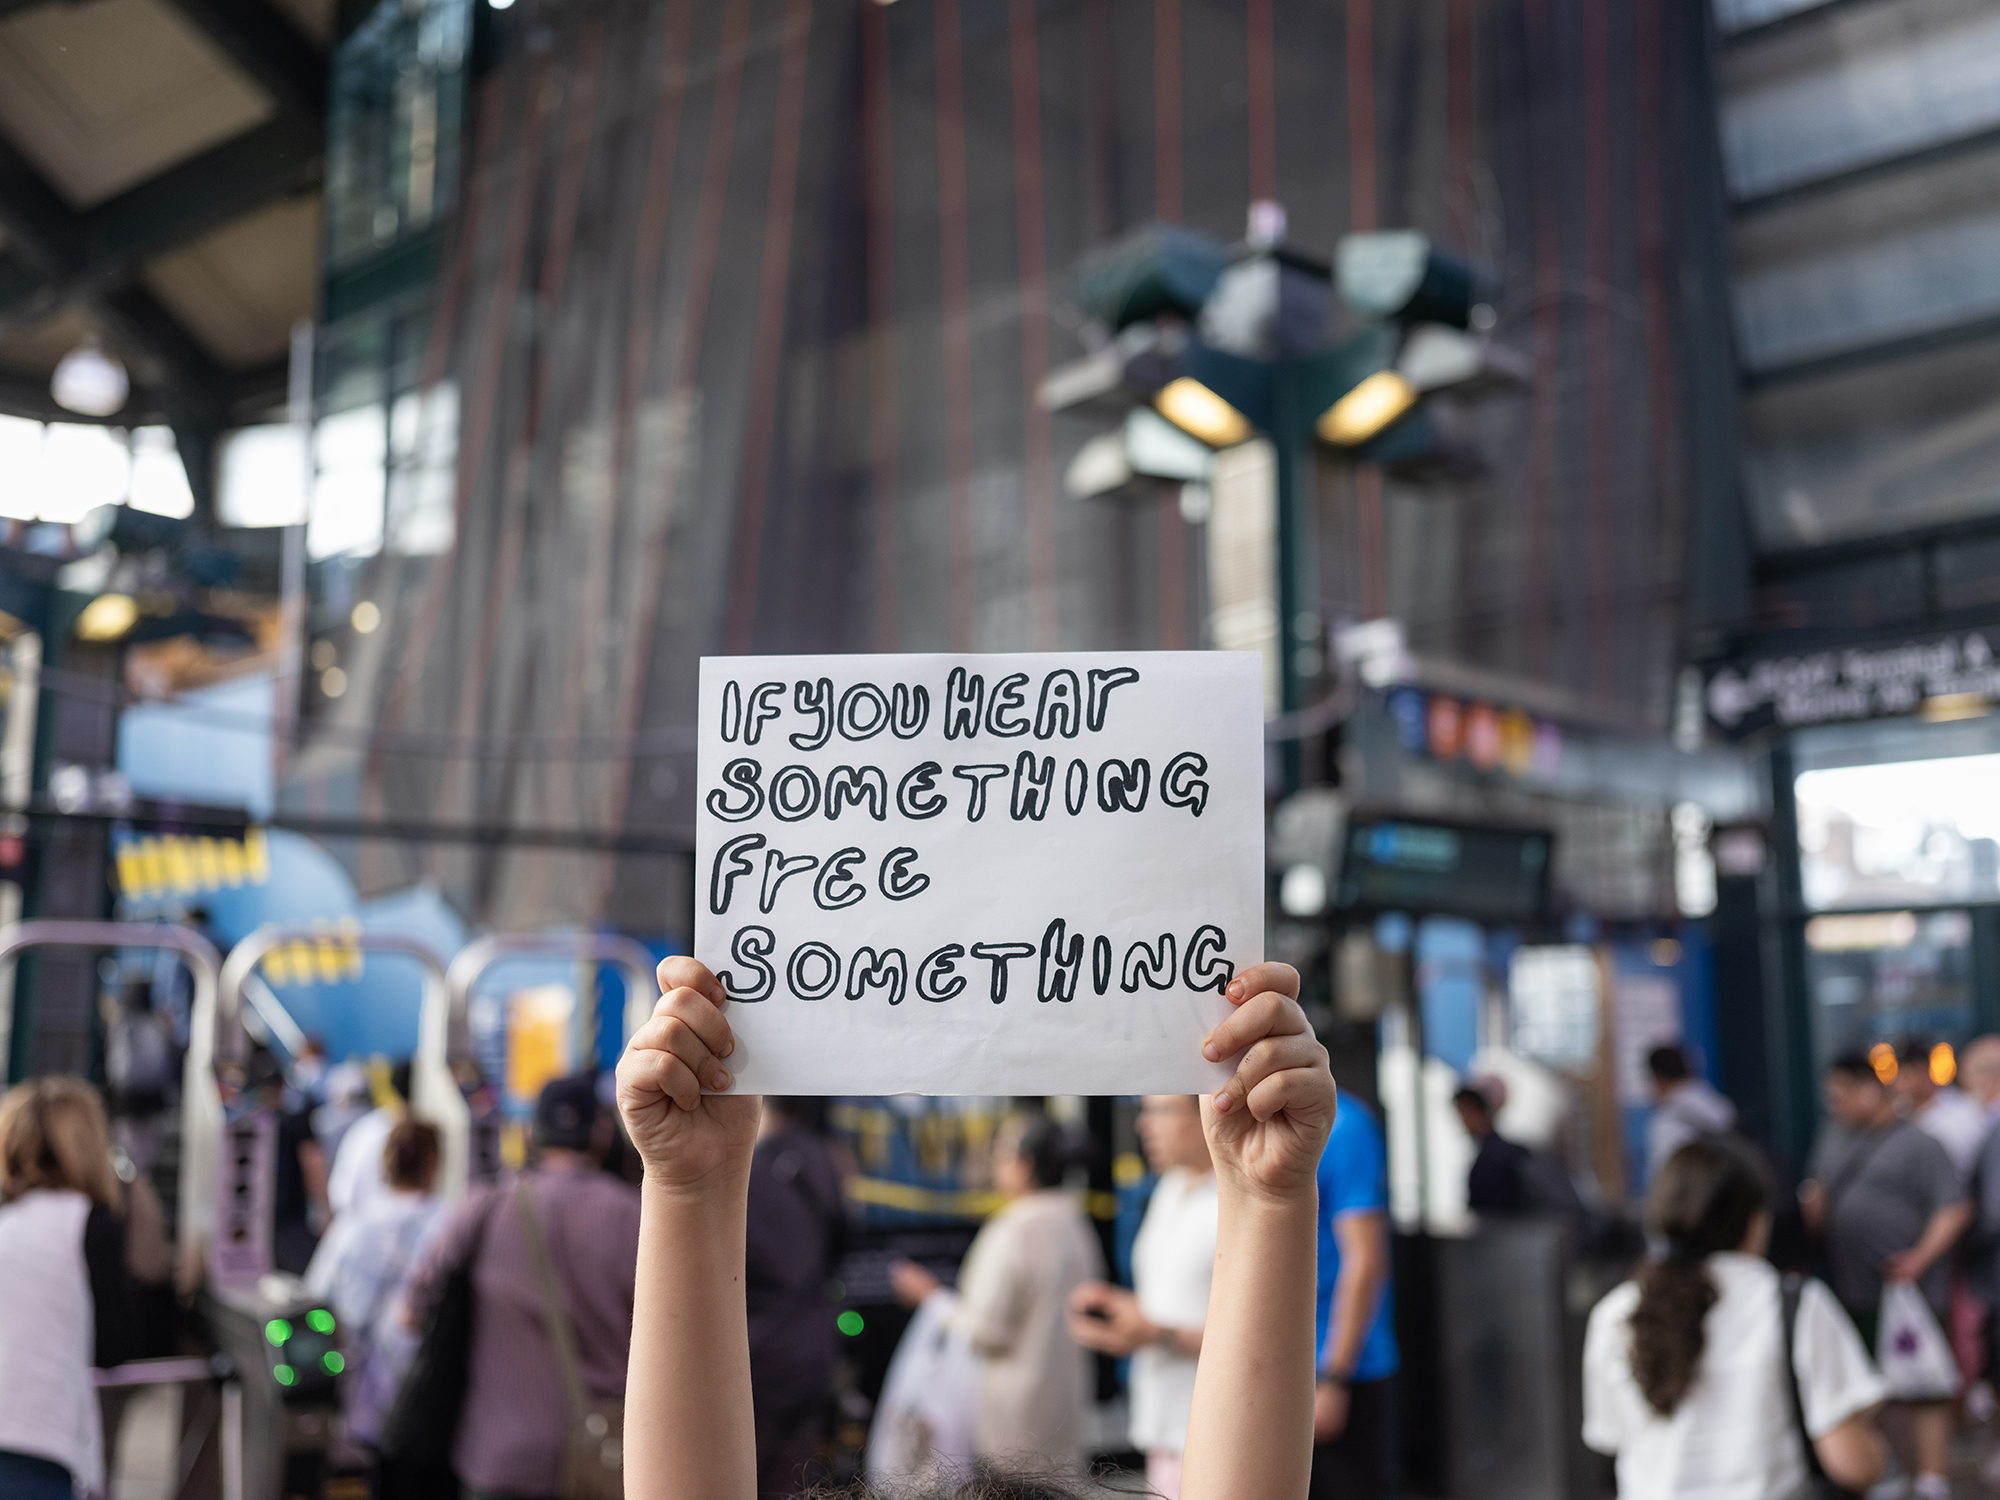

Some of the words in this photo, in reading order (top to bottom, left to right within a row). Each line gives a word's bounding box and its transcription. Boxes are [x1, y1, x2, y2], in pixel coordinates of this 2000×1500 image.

[720, 681, 786, 745] IF
[706, 751, 1210, 823] SOMETHING
[715, 918, 1235, 1005] SOMETHING
